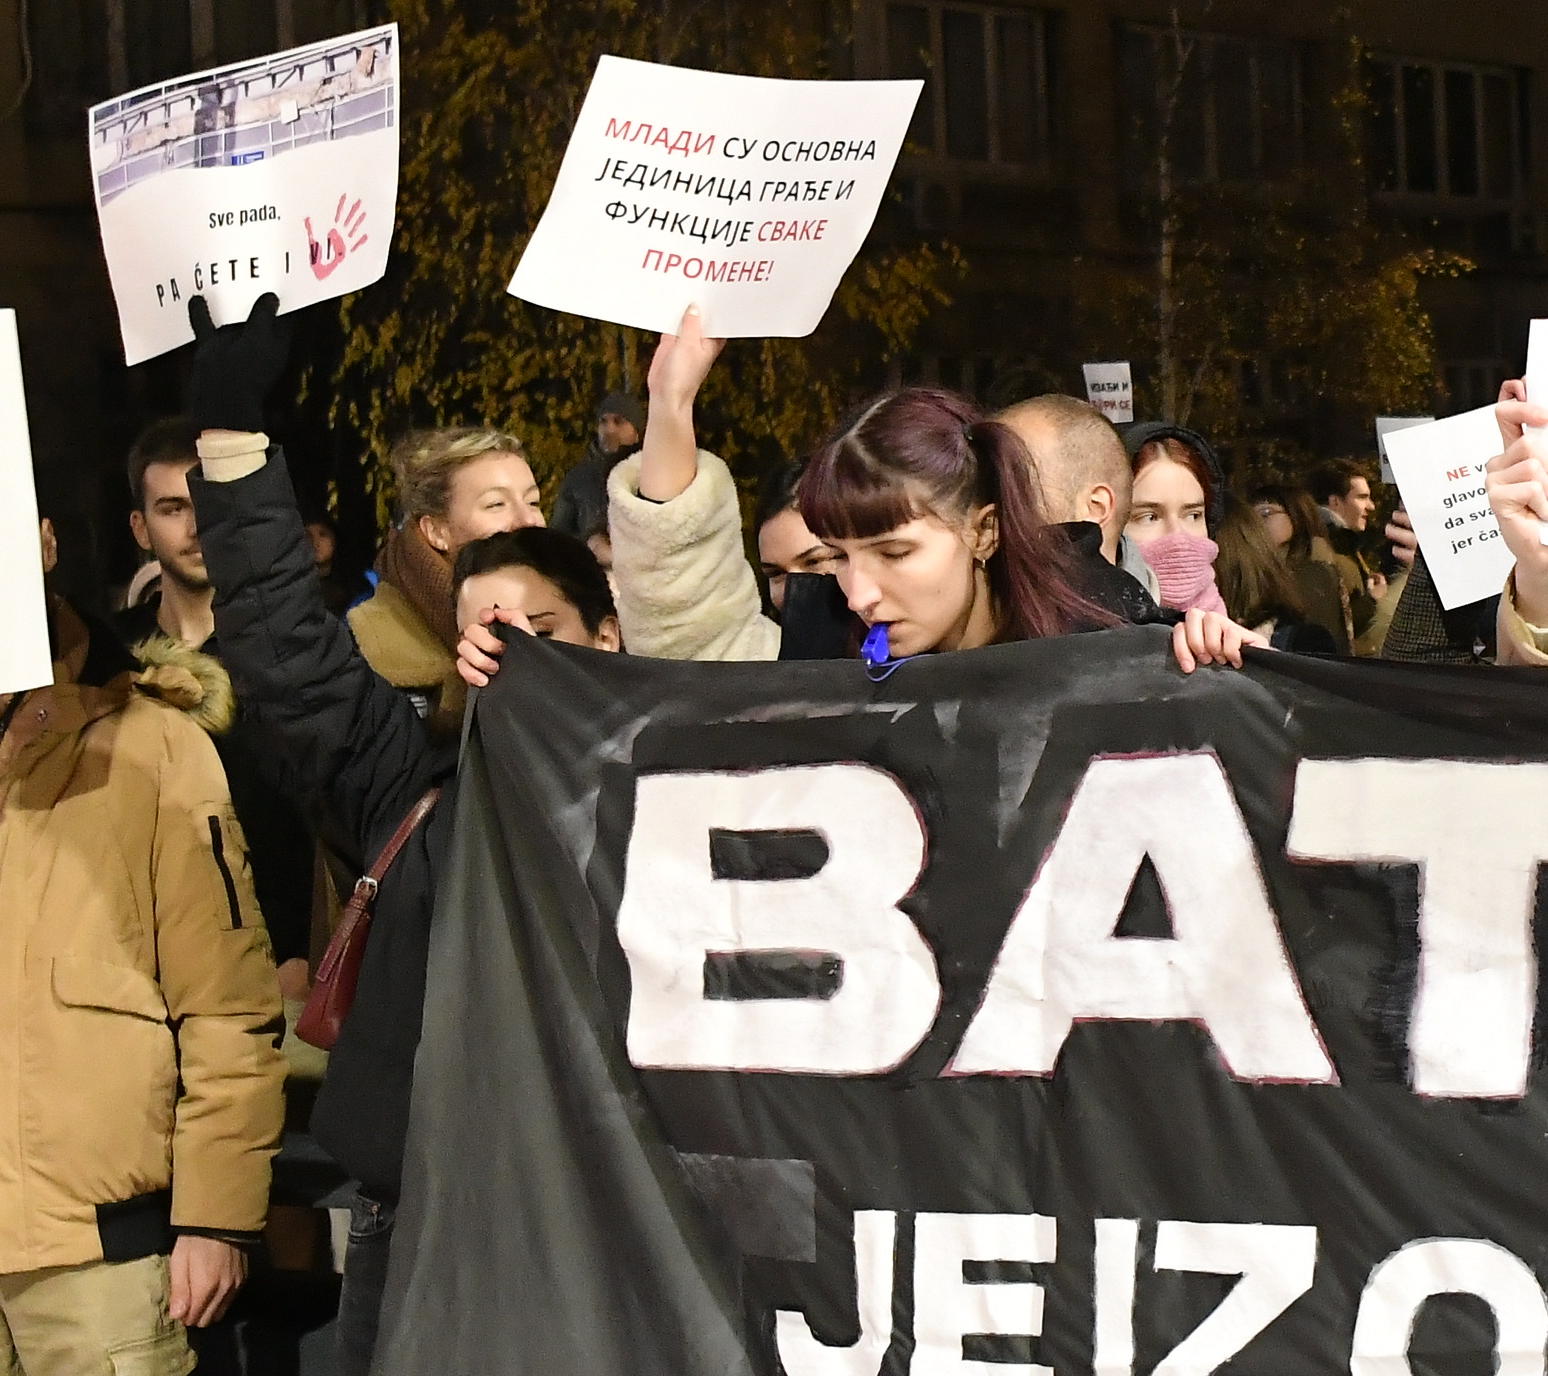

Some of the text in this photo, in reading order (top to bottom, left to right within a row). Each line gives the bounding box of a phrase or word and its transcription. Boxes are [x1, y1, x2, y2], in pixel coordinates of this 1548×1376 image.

[604, 117, 876, 162] МЛАДИ СУ ОСНОВНА
[594, 157, 856, 206] ЈЕДИНИЦА ГРАЂЕ И
[209, 204, 281, 229] Sve pada,
[605, 200, 829, 248] ФУНКЦИЈЕ СВАКЕ
[155, 277, 181, 308] PA
[194, 256, 260, 292] ĆETE
[285, 251, 290, 274] I
[642, 248, 775, 283] ПРОМЕНЕ!
[1446, 465, 1470, 481] NE
[1442, 487, 1487, 509] glavo
[1444, 517, 1465, 530] da
[1451, 536, 1474, 555] jer
